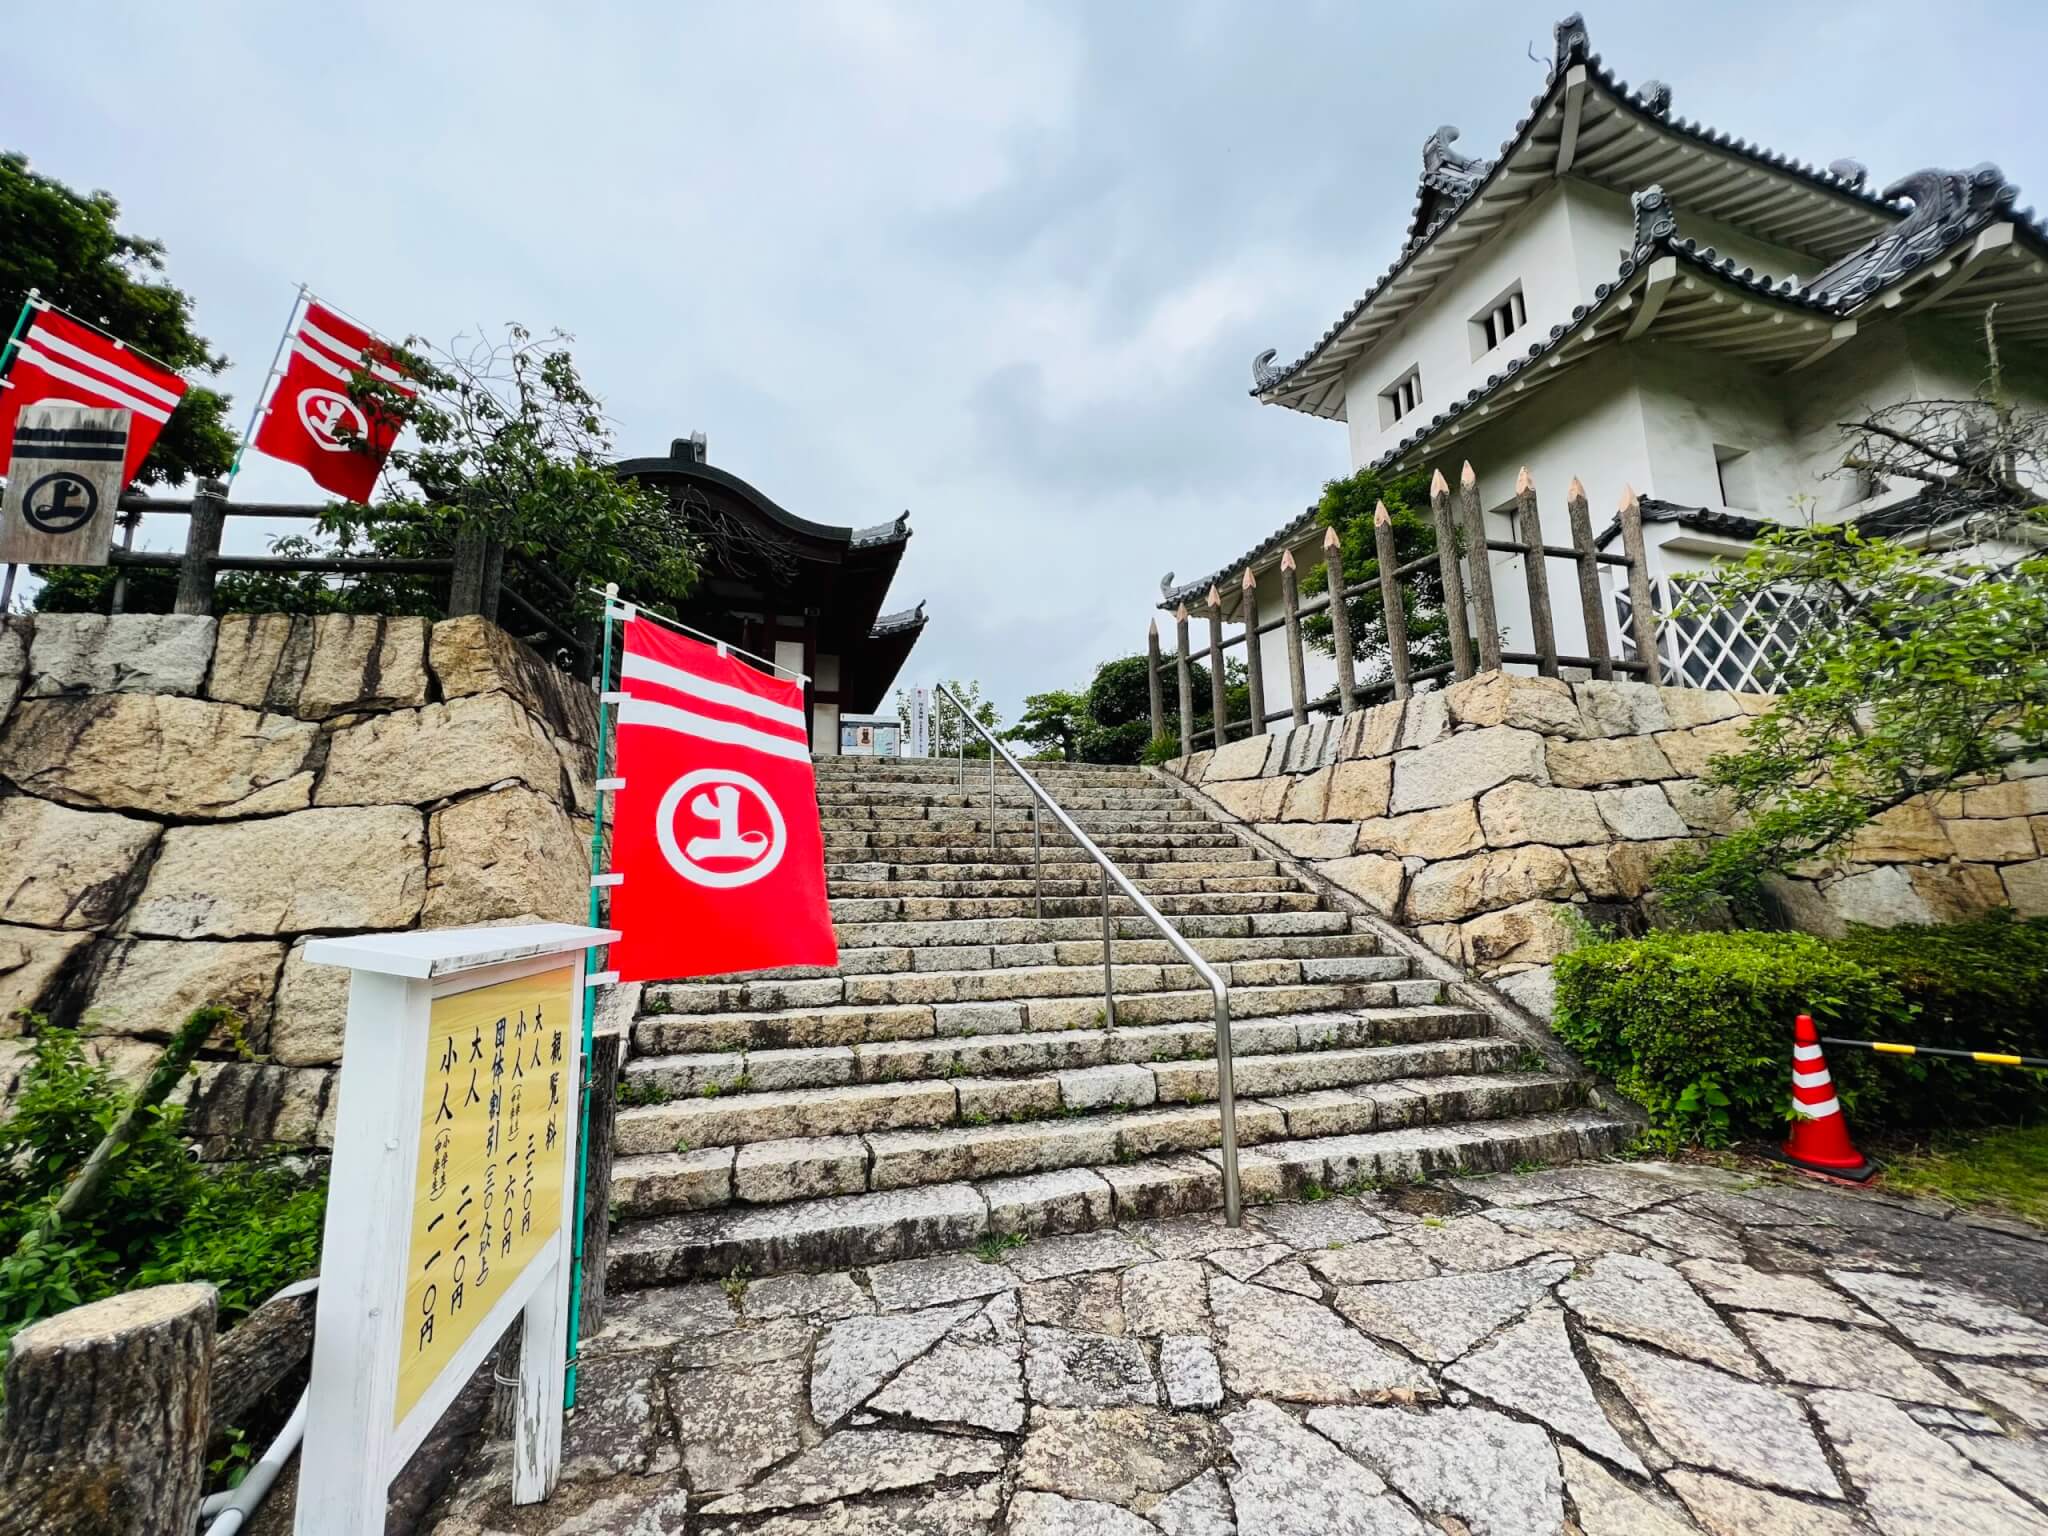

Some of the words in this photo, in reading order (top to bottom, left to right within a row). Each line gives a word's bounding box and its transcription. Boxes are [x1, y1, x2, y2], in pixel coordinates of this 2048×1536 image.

[435, 1036, 458, 1125] 小人
[464, 1025, 484, 1108] 大人
[511, 1010, 527, 1081] 小人
[530, 1003, 544, 1070] 大人
[451, 1184, 473, 1316] 二二〇円
[501, 1152, 518, 1259] 一六〇円
[419, 1212, 444, 1352] 一一〇円
